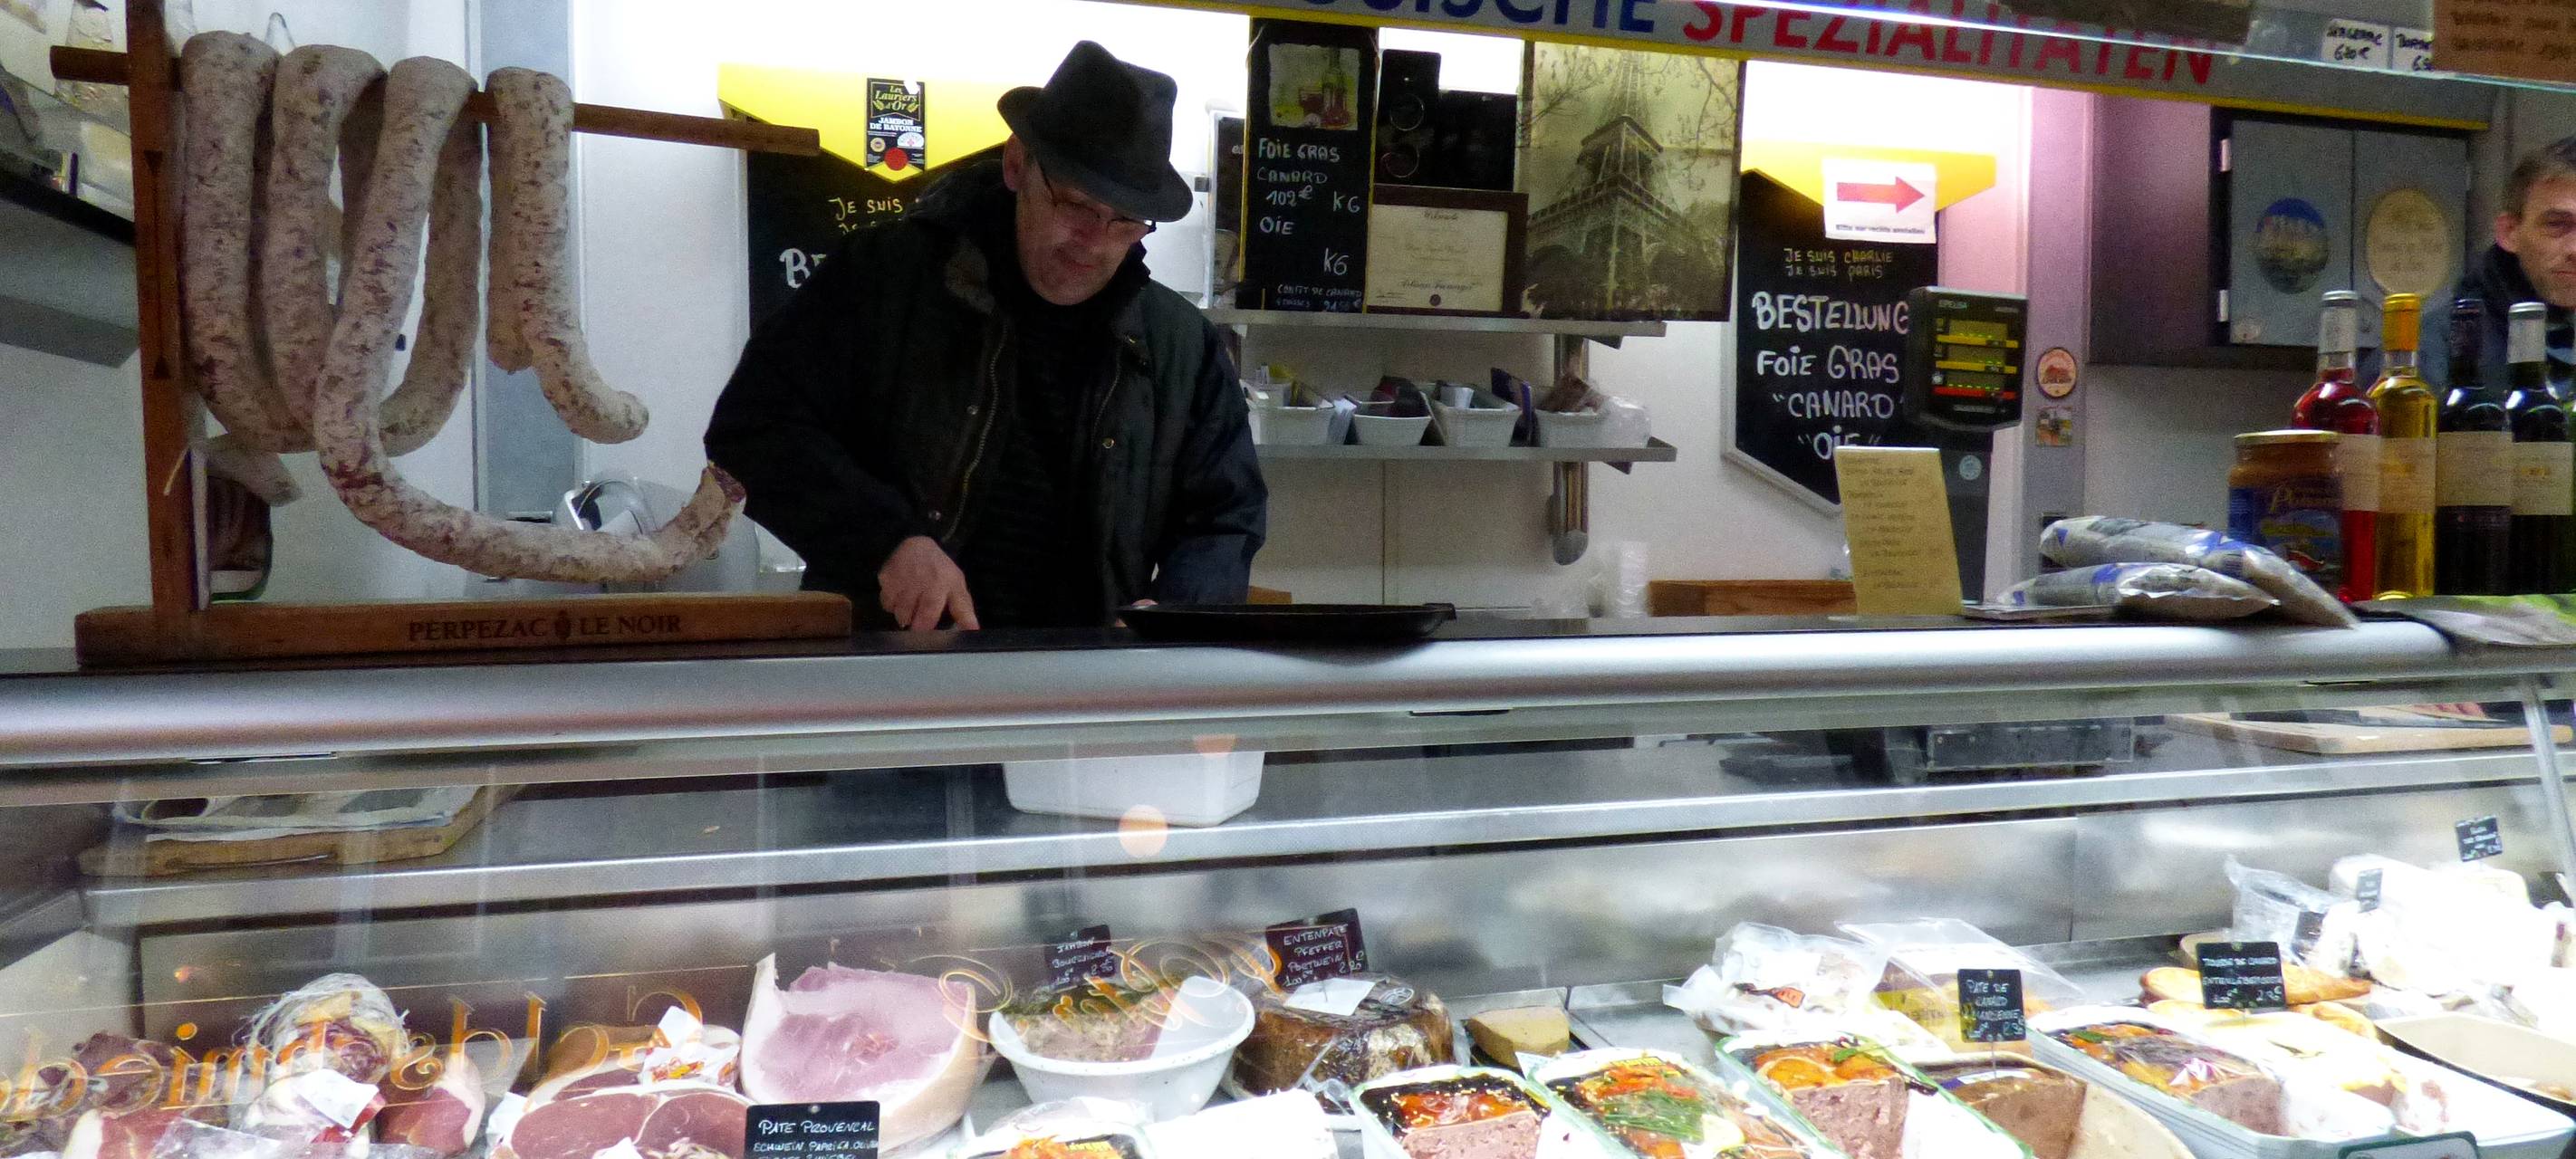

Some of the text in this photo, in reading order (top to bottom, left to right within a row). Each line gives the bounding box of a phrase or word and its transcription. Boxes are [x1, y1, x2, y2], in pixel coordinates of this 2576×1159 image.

[879, 117, 915, 126] JAMBON
[884, 123, 923, 133] BAYONNE
[1258, 137, 1293, 158] FOIE
[1257, 167, 1328, 184] CANARD
[828, 196, 904, 221] JE SUIS
[1260, 216, 1295, 235] OIE
[1807, 250, 1836, 263] SUIS
[1752, 291, 1910, 335] BESTELLUNG
[1757, 345, 1900, 384] FOIE GRAS
[409, 615, 681, 641] PERPEZAC LE NOIR
[758, 1119, 876, 1135] PATE PROVENCAL
